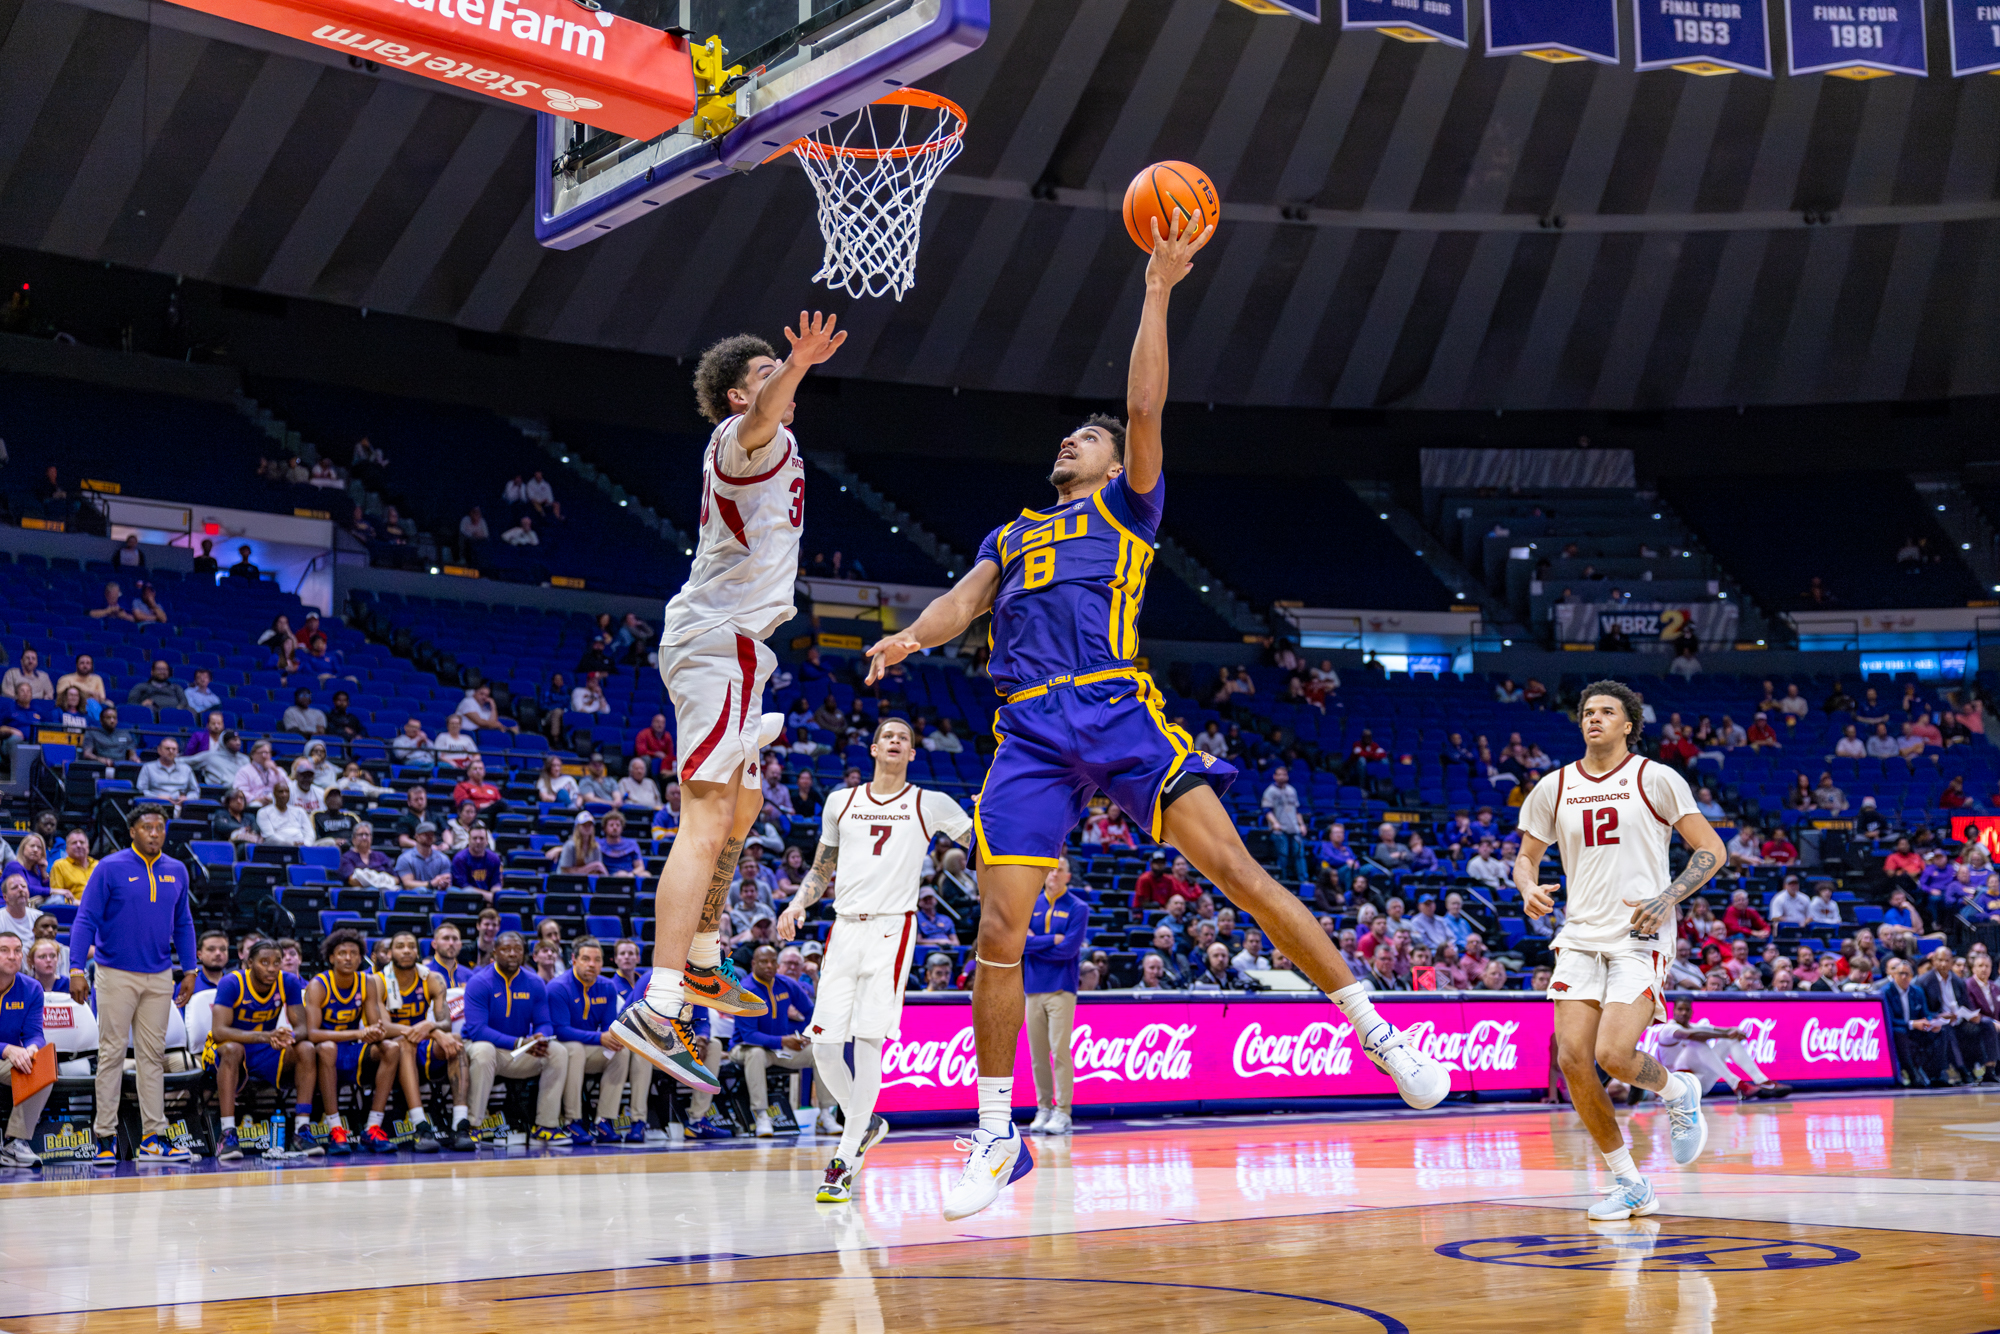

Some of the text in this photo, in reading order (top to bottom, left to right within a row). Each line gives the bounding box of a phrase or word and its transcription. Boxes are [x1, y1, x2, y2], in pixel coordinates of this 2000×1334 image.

[1660, 0, 1742, 19] FINAL FOUR
[1813, 6, 1898, 22] FINAL FOUR
[1674, 19, 1731, 45] 1953
[1830, 25, 1884, 48] 1981
[1002, 514, 1088, 568] LSU
[1023, 546, 1056, 590] 8
[1601, 614, 1660, 635] WBRZ
[1049, 675, 1071, 687] LSU
[1566, 792, 1630, 805] RAZORBACKS
[851, 813, 910, 821] RAZORBACKS
[1582, 807, 1620, 847] 12
[870, 825, 892, 856] 7
[159, 875, 175, 883] LSU
[238, 1008, 280, 1023] LSU
[324, 1009, 361, 1024] LSU
[1233, 1021, 1353, 1077] Coca-Cola
[1411, 1020, 1519, 1072] Coca-Cola
[1801, 1017, 1880, 1063] Coca-Cola
[881, 1026, 978, 1088] oca-Co
[238, 1120, 268, 1140] engal
